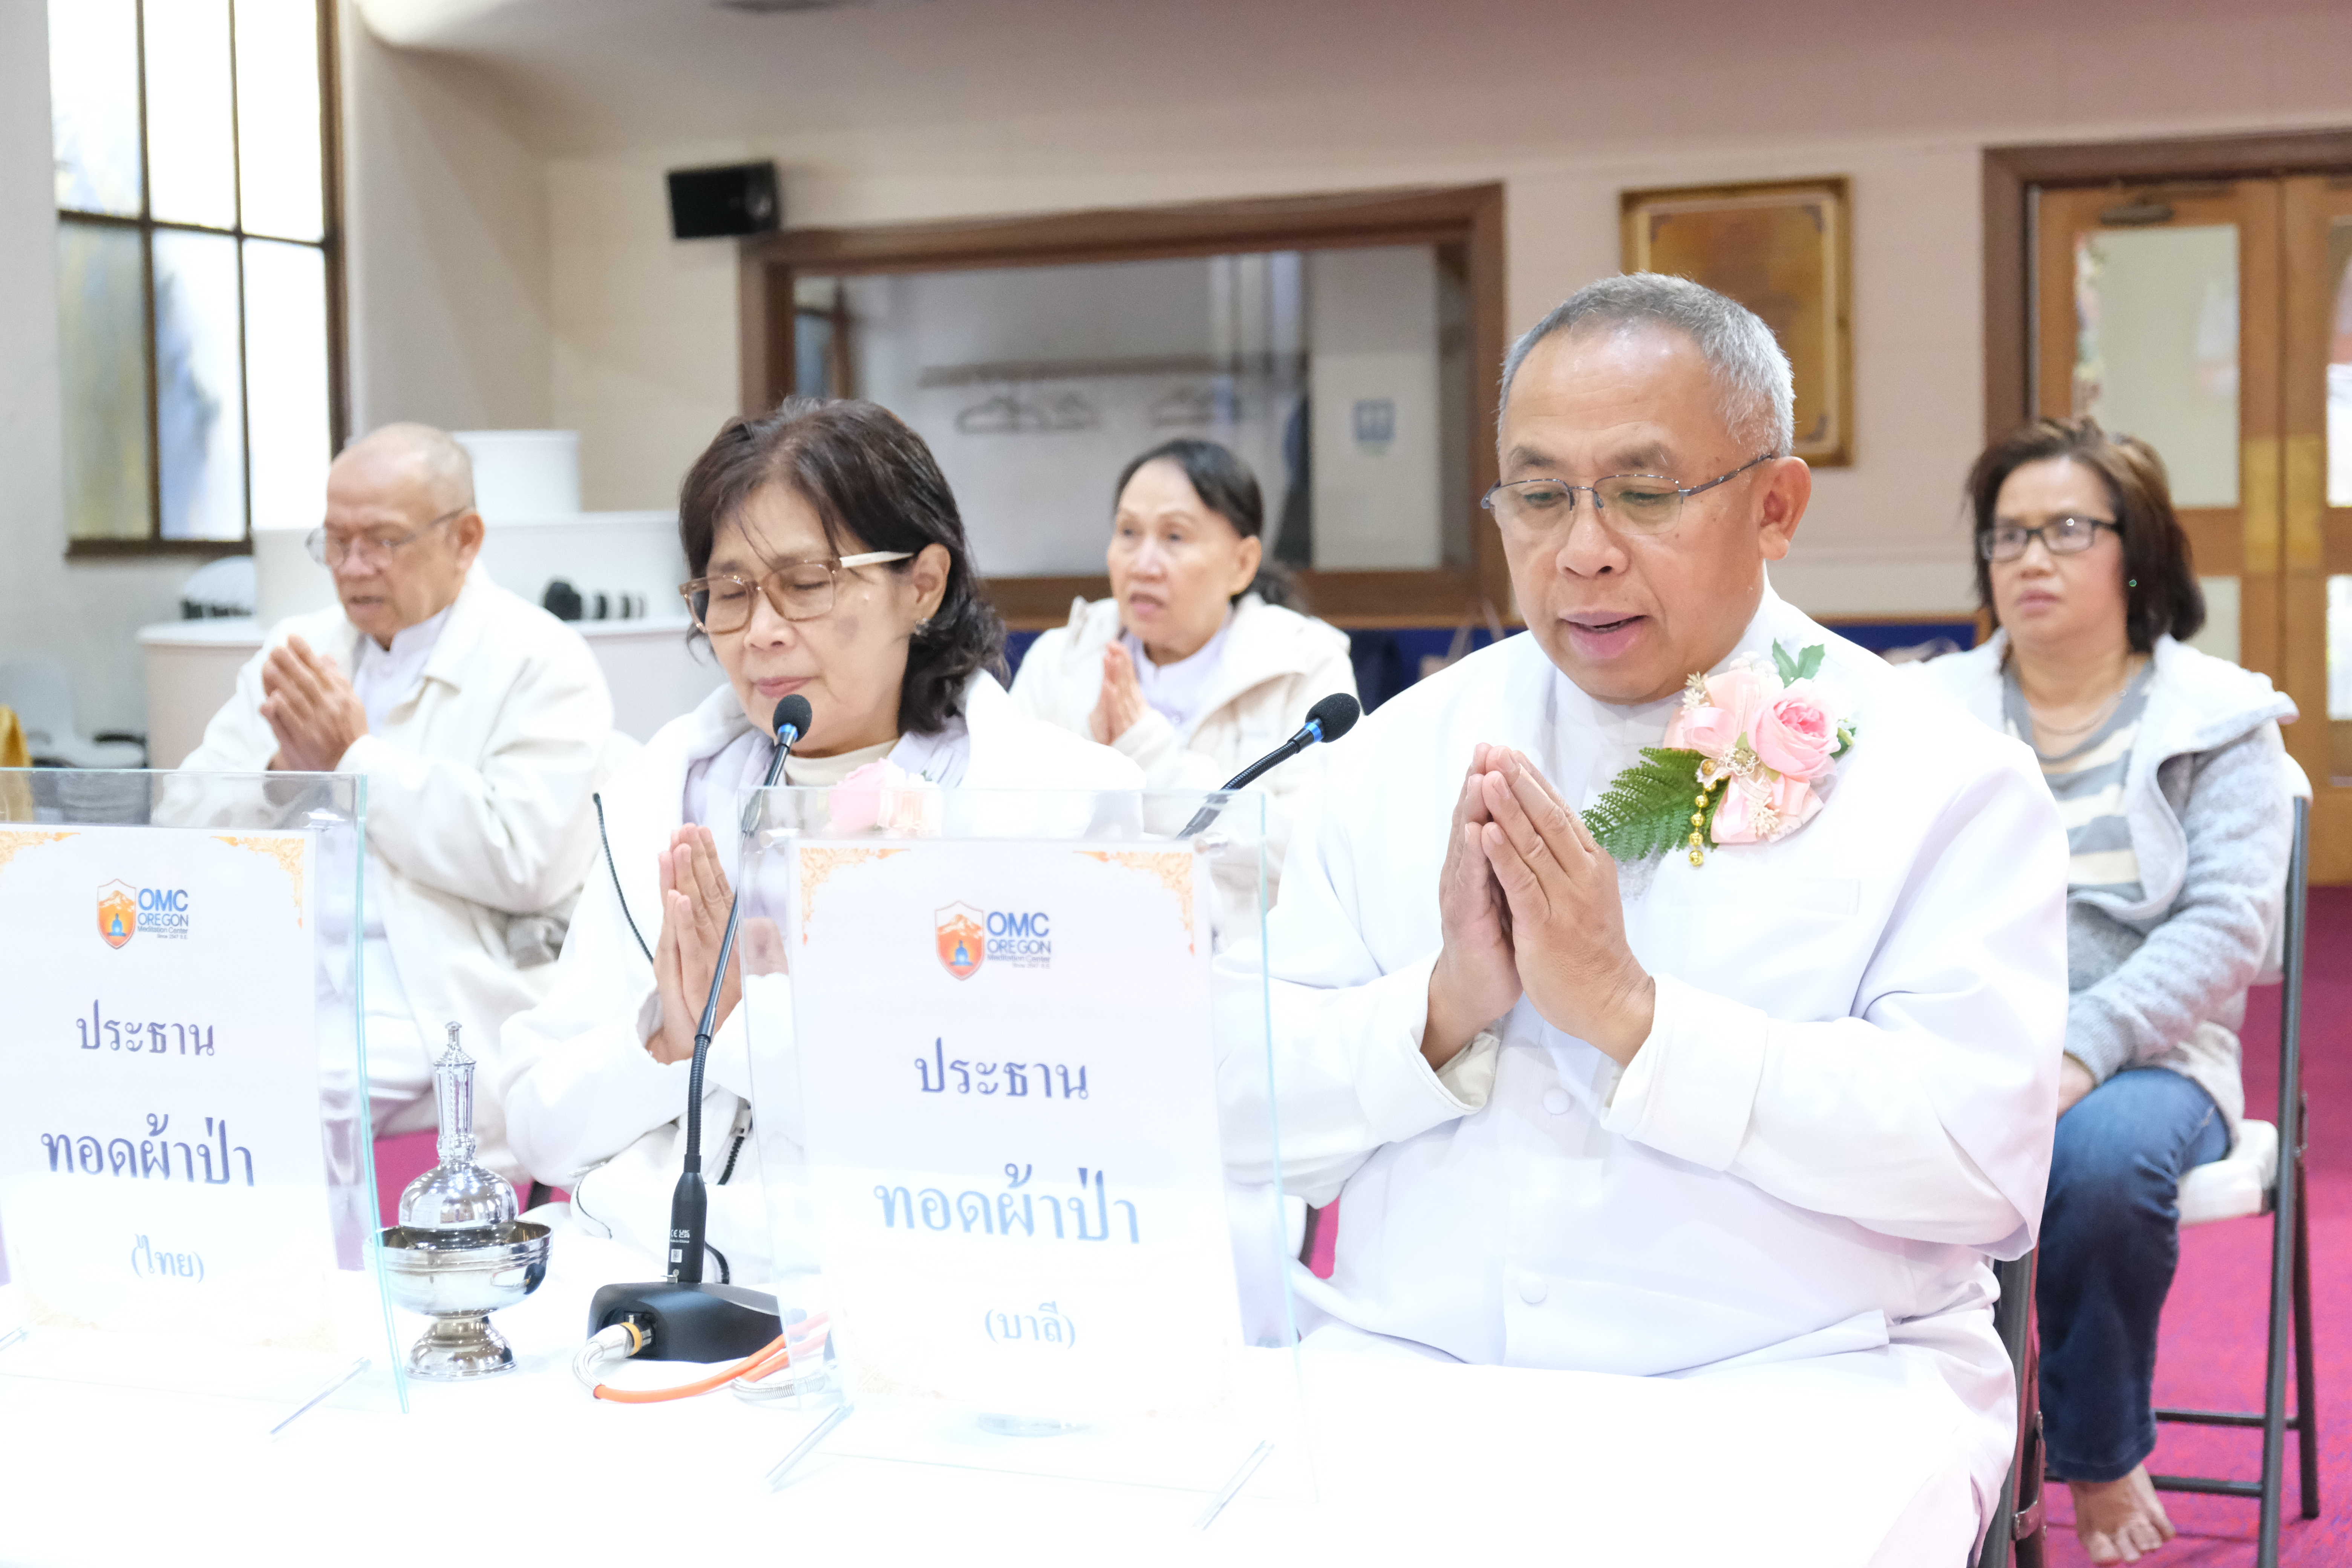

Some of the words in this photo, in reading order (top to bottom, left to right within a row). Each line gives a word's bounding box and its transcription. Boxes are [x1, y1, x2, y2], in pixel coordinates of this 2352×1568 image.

[138, 888, 188, 912] OMC
[138, 913, 188, 926] OREGON
[987, 911, 1049, 938] OMC
[987, 939, 1051, 954] OREGON
[76, 999, 214, 1056] ประธาน
[914, 1037, 1089, 1100] ประธาน
[41, 1113, 254, 1187] ทอดผ้าป่า
[873, 1163, 1139, 1244] ทอดผ้าป่า
[131, 1234, 204, 1283] (ไทย)
[985, 1302, 1076, 1349] (บาลี)
